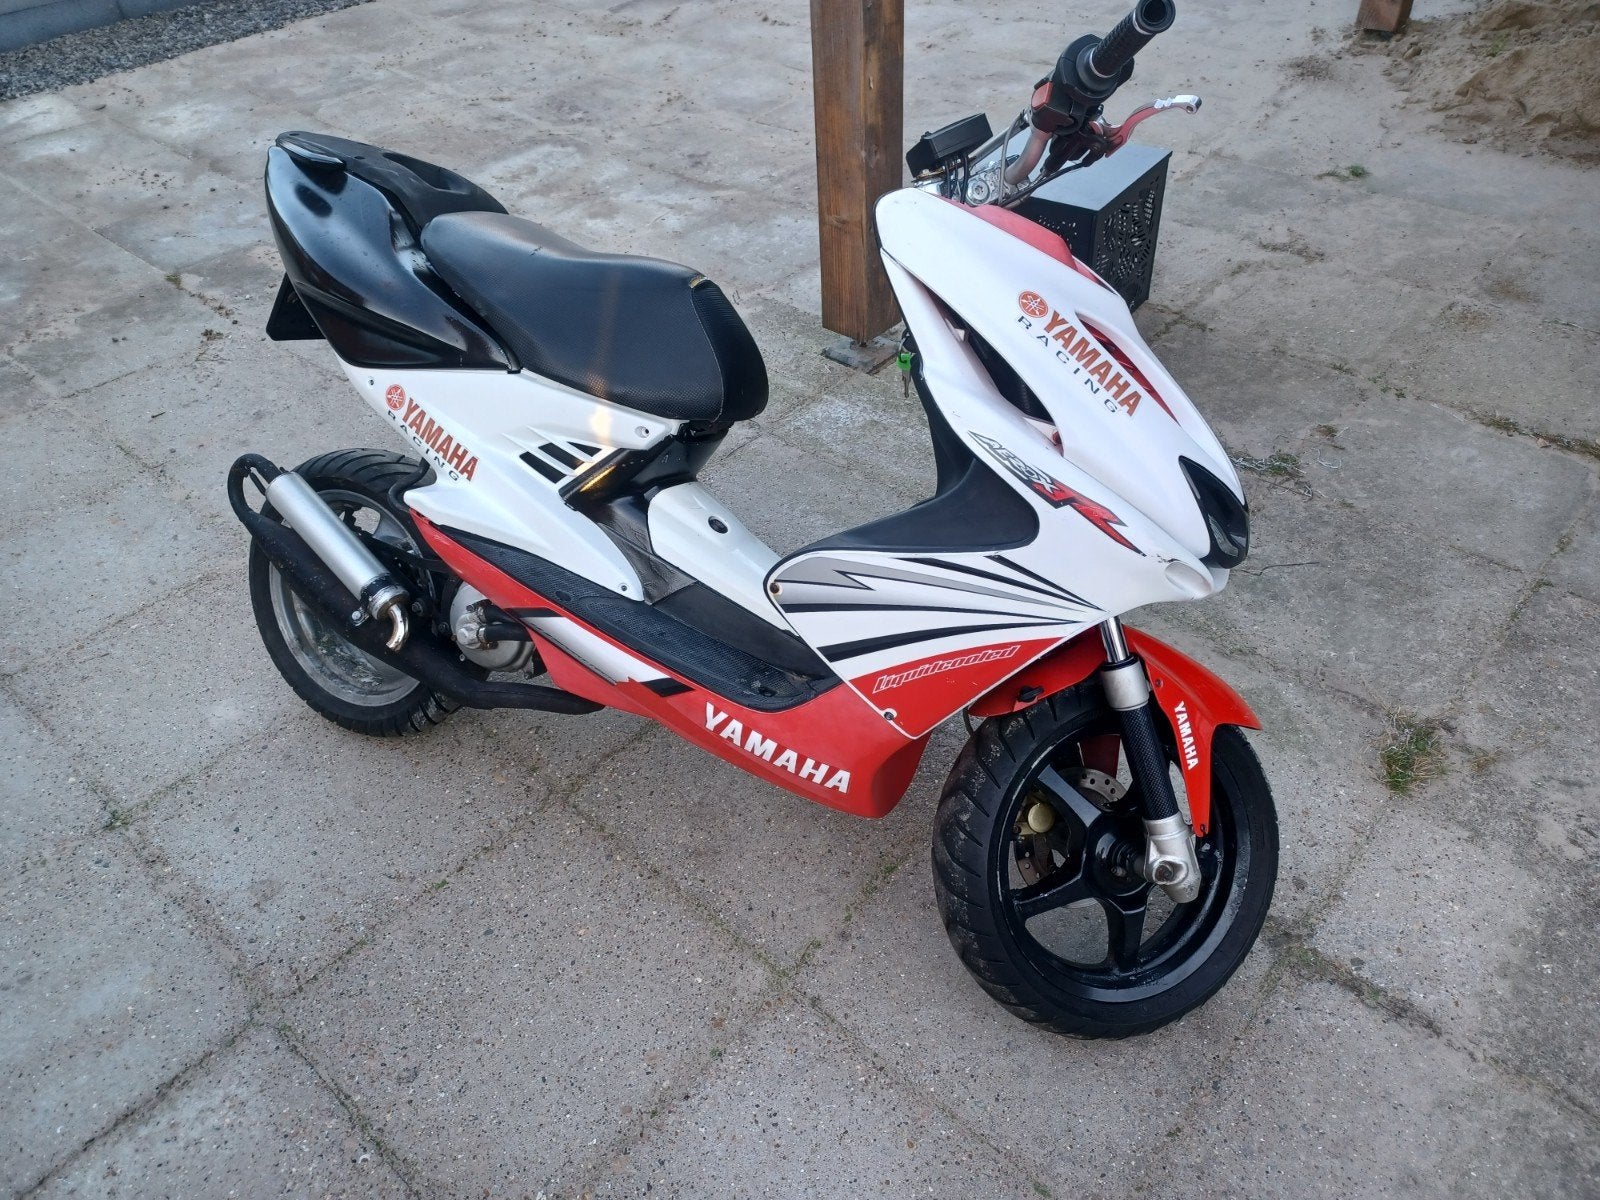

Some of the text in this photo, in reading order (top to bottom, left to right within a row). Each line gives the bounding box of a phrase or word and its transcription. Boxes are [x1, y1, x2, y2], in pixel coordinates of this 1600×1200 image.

[1017, 315, 1118, 414] RACING
[1043, 310, 1142, 417] YAMAHA
[387, 410, 460, 481] RACING
[402, 397, 479, 481] YAMAHA
[704, 702, 851, 794] YAMAHA
[1174, 700, 1199, 771] YAMAHA
